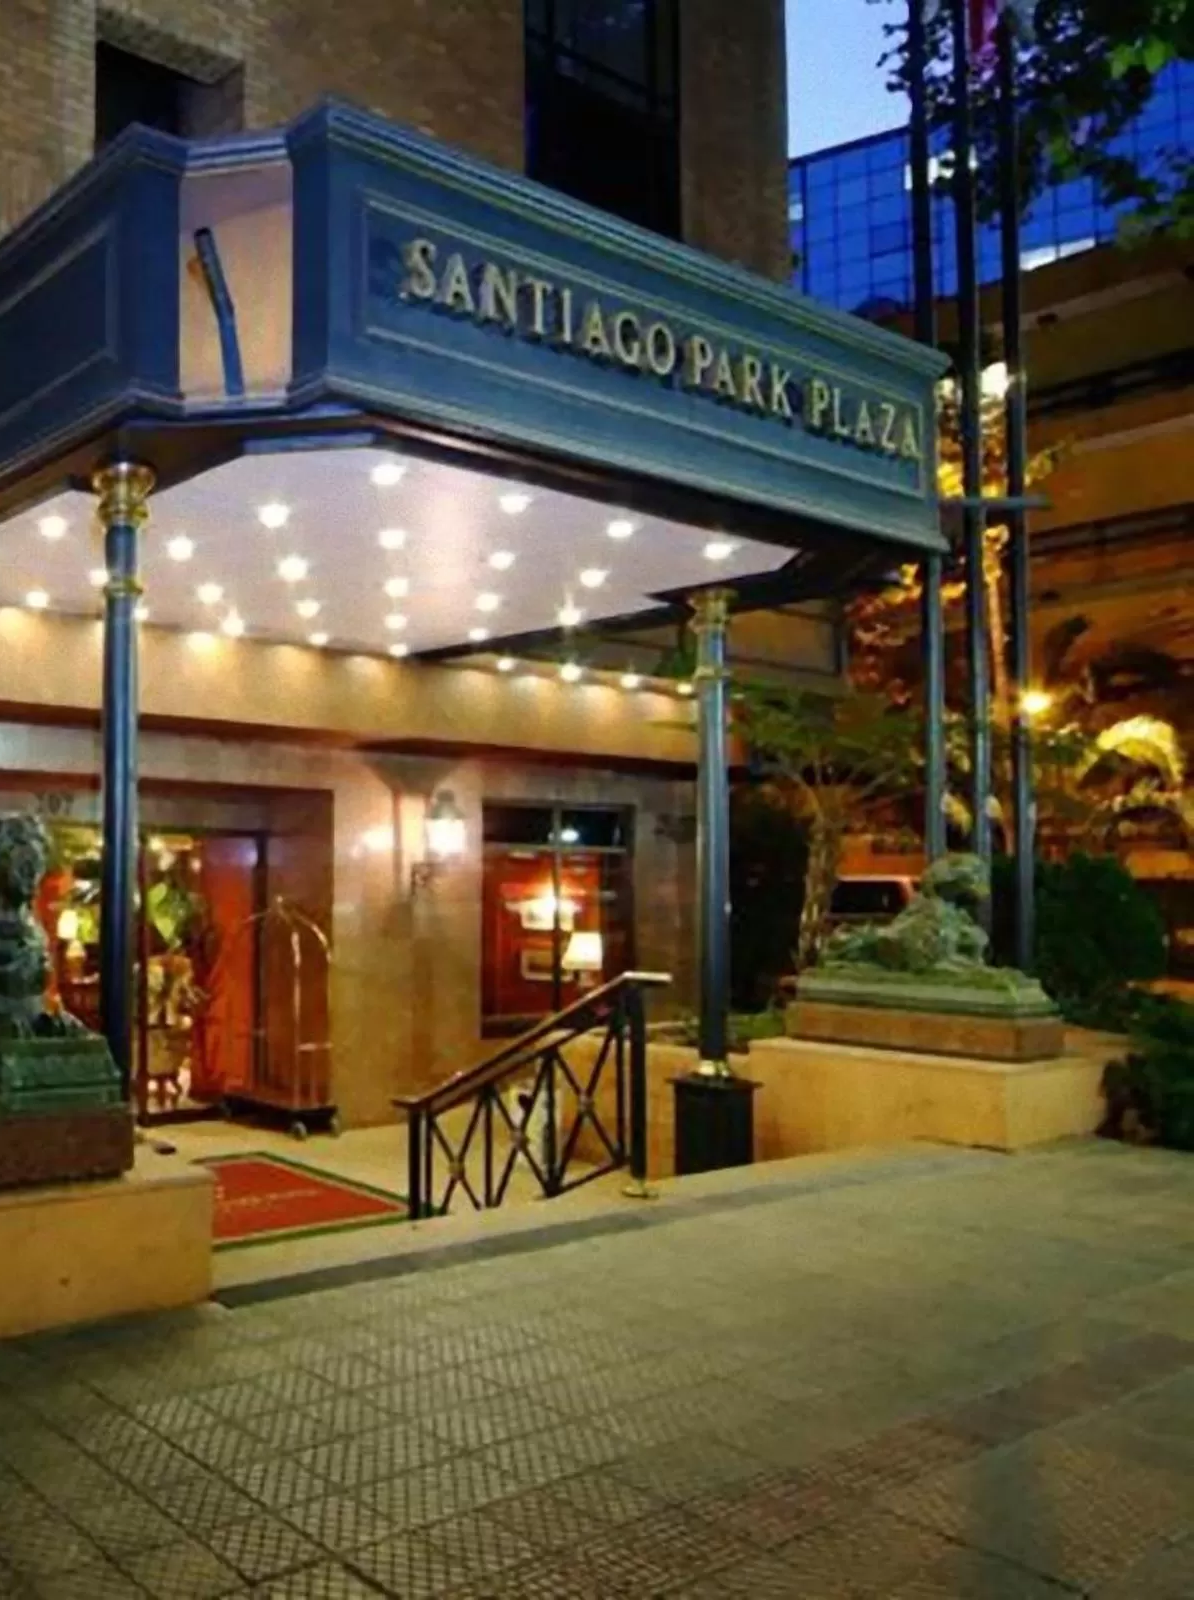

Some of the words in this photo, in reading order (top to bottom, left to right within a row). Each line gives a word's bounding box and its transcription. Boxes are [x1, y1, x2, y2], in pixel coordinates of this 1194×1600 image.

[406, 238, 676, 375] SANTIAGO
[686, 334, 793, 418] PARK
[811, 377, 923, 458] PLAZA
